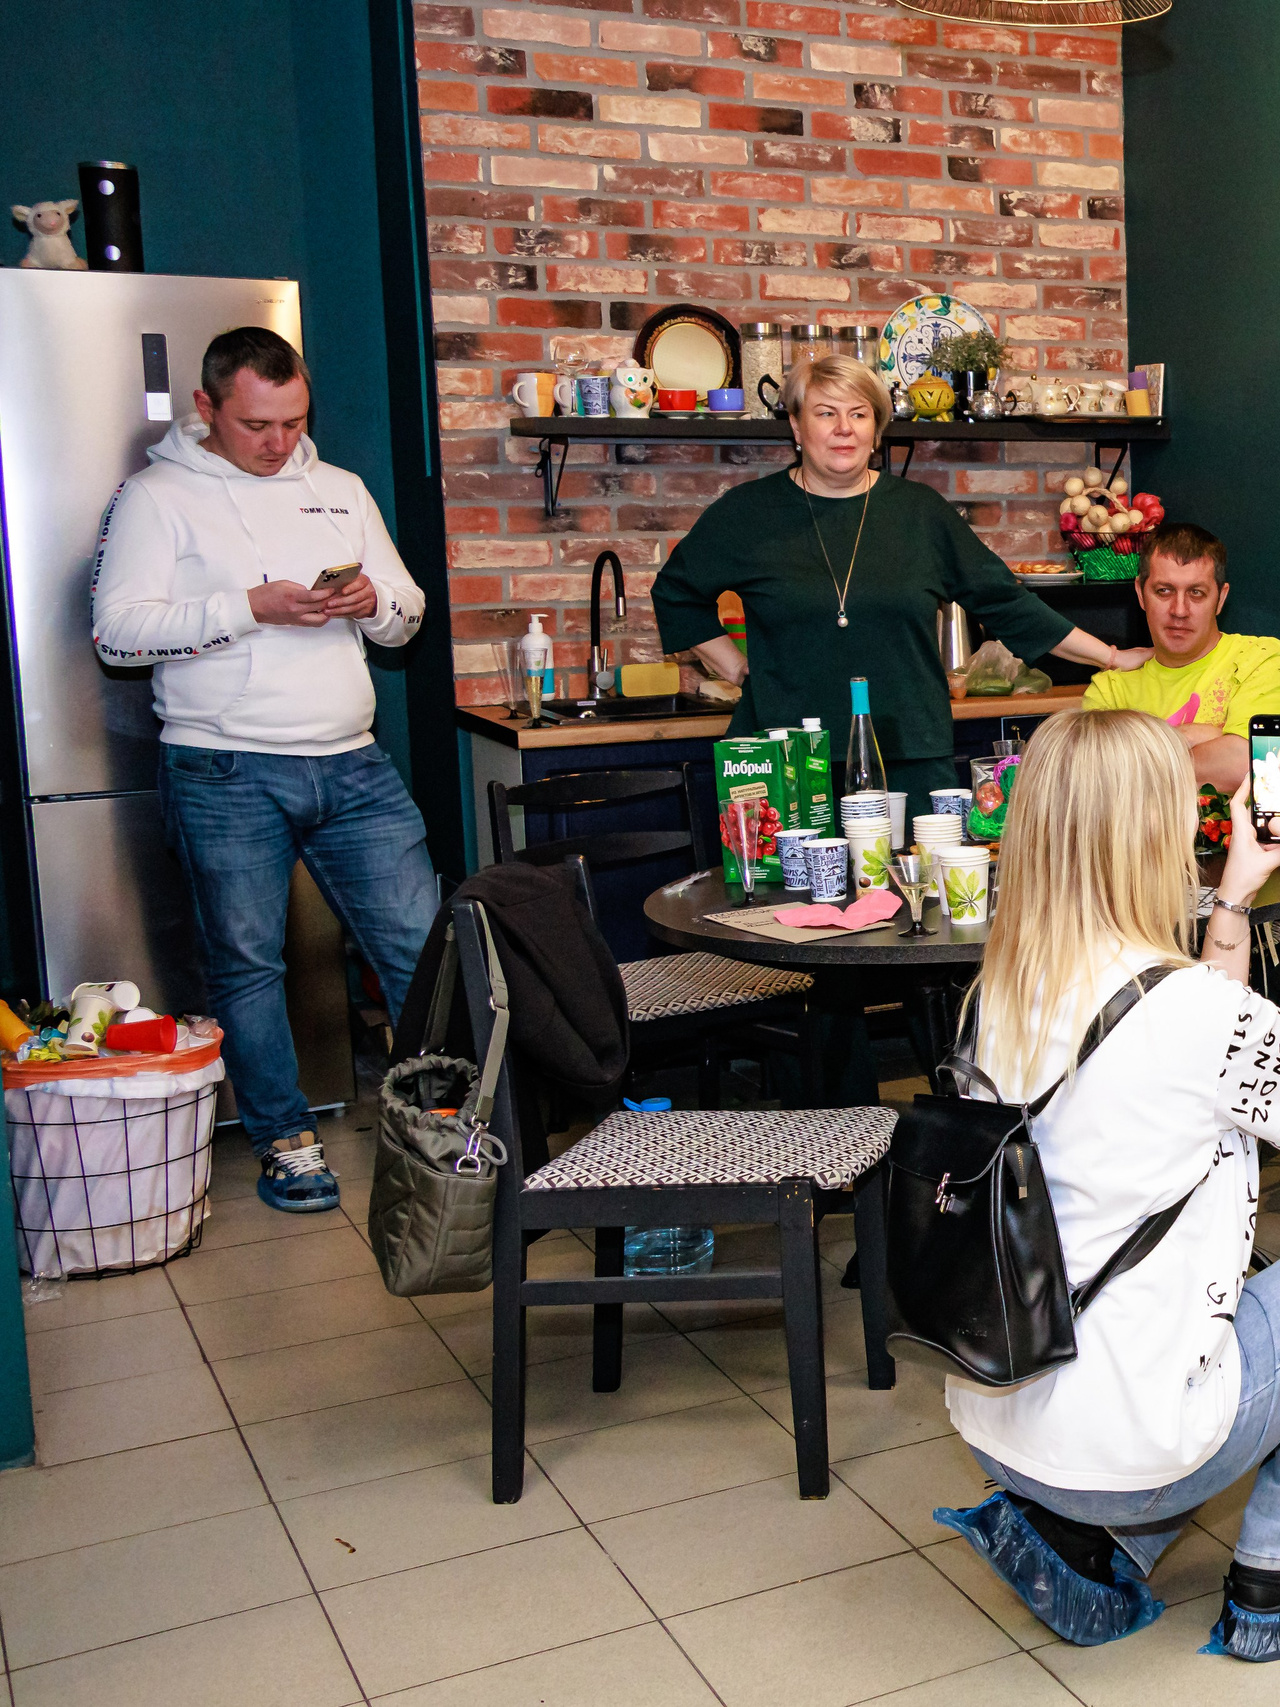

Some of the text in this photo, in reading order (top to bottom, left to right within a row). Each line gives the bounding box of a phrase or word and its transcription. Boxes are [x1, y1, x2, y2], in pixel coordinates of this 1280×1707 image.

[202, 633, 232, 650] ANS
[147, 646, 200, 657] TOMMY
[722, 758, 773, 778] Добрый
